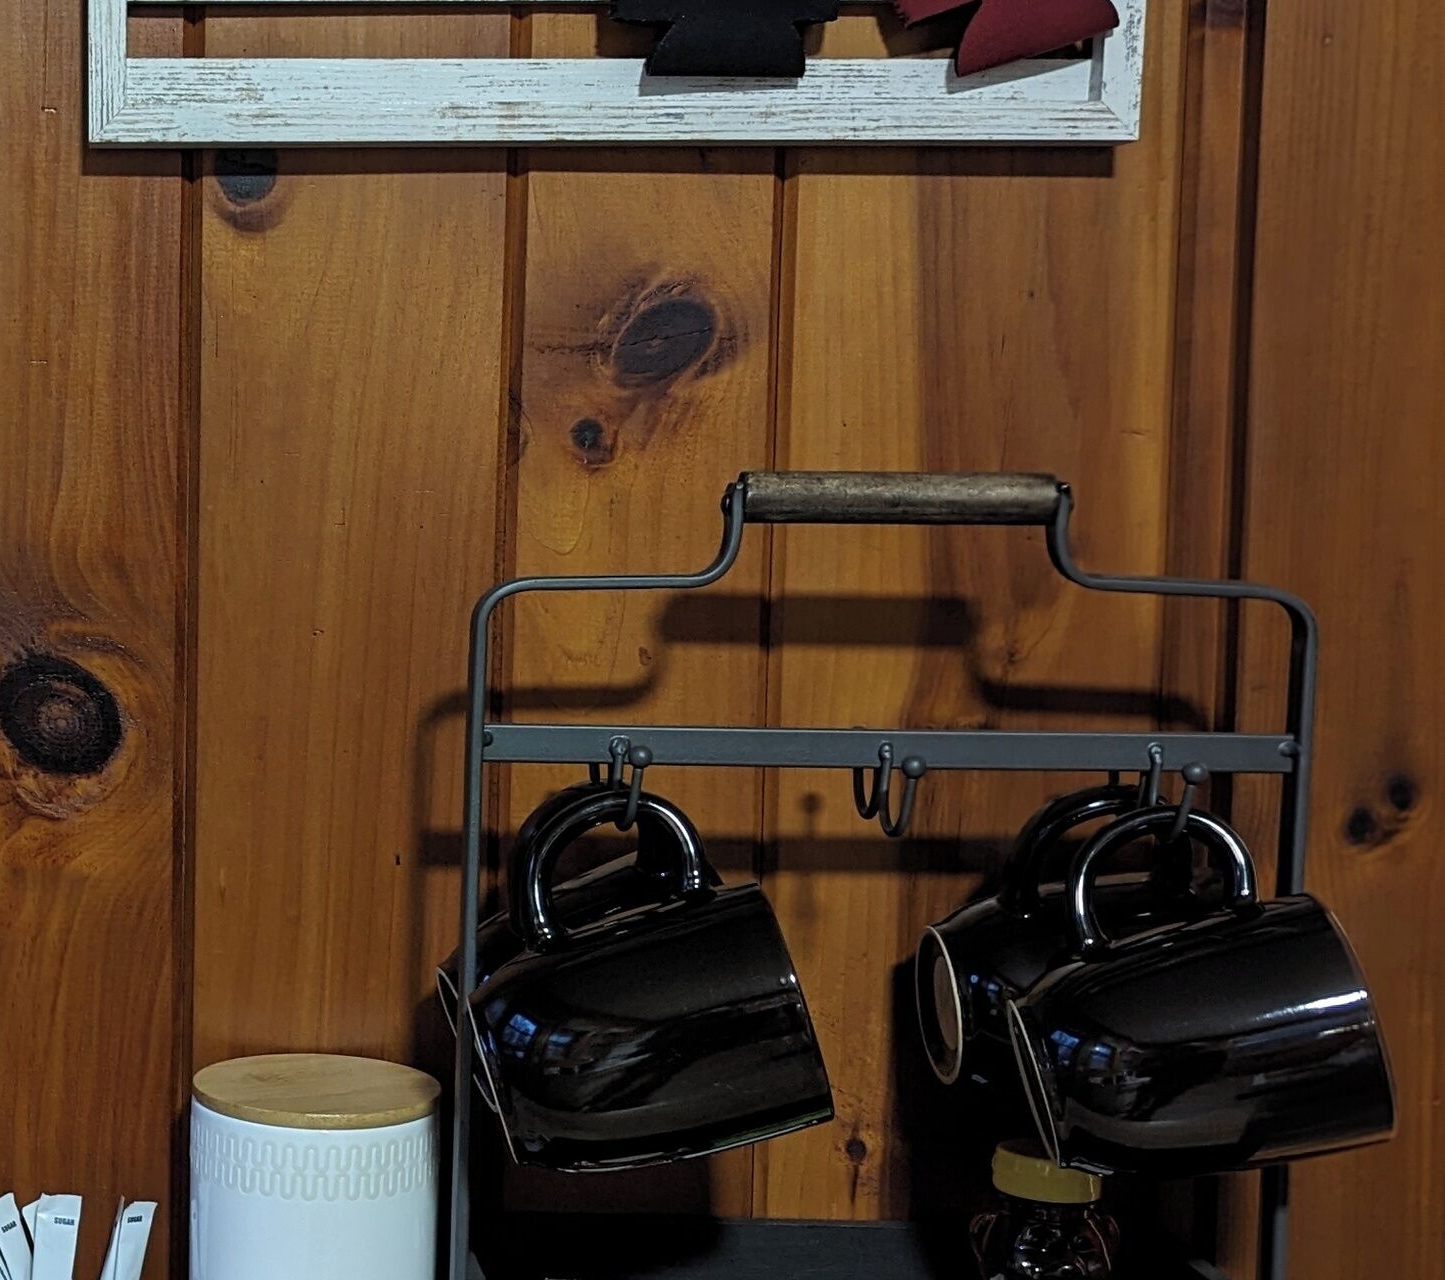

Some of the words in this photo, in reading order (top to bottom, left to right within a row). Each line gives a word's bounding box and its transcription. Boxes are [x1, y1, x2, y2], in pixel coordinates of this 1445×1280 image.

[54, 1217, 75, 1226] SUGAR
[127, 1215, 143, 1224] SUGAR
[1, 1220, 17, 1233] SUGAR
